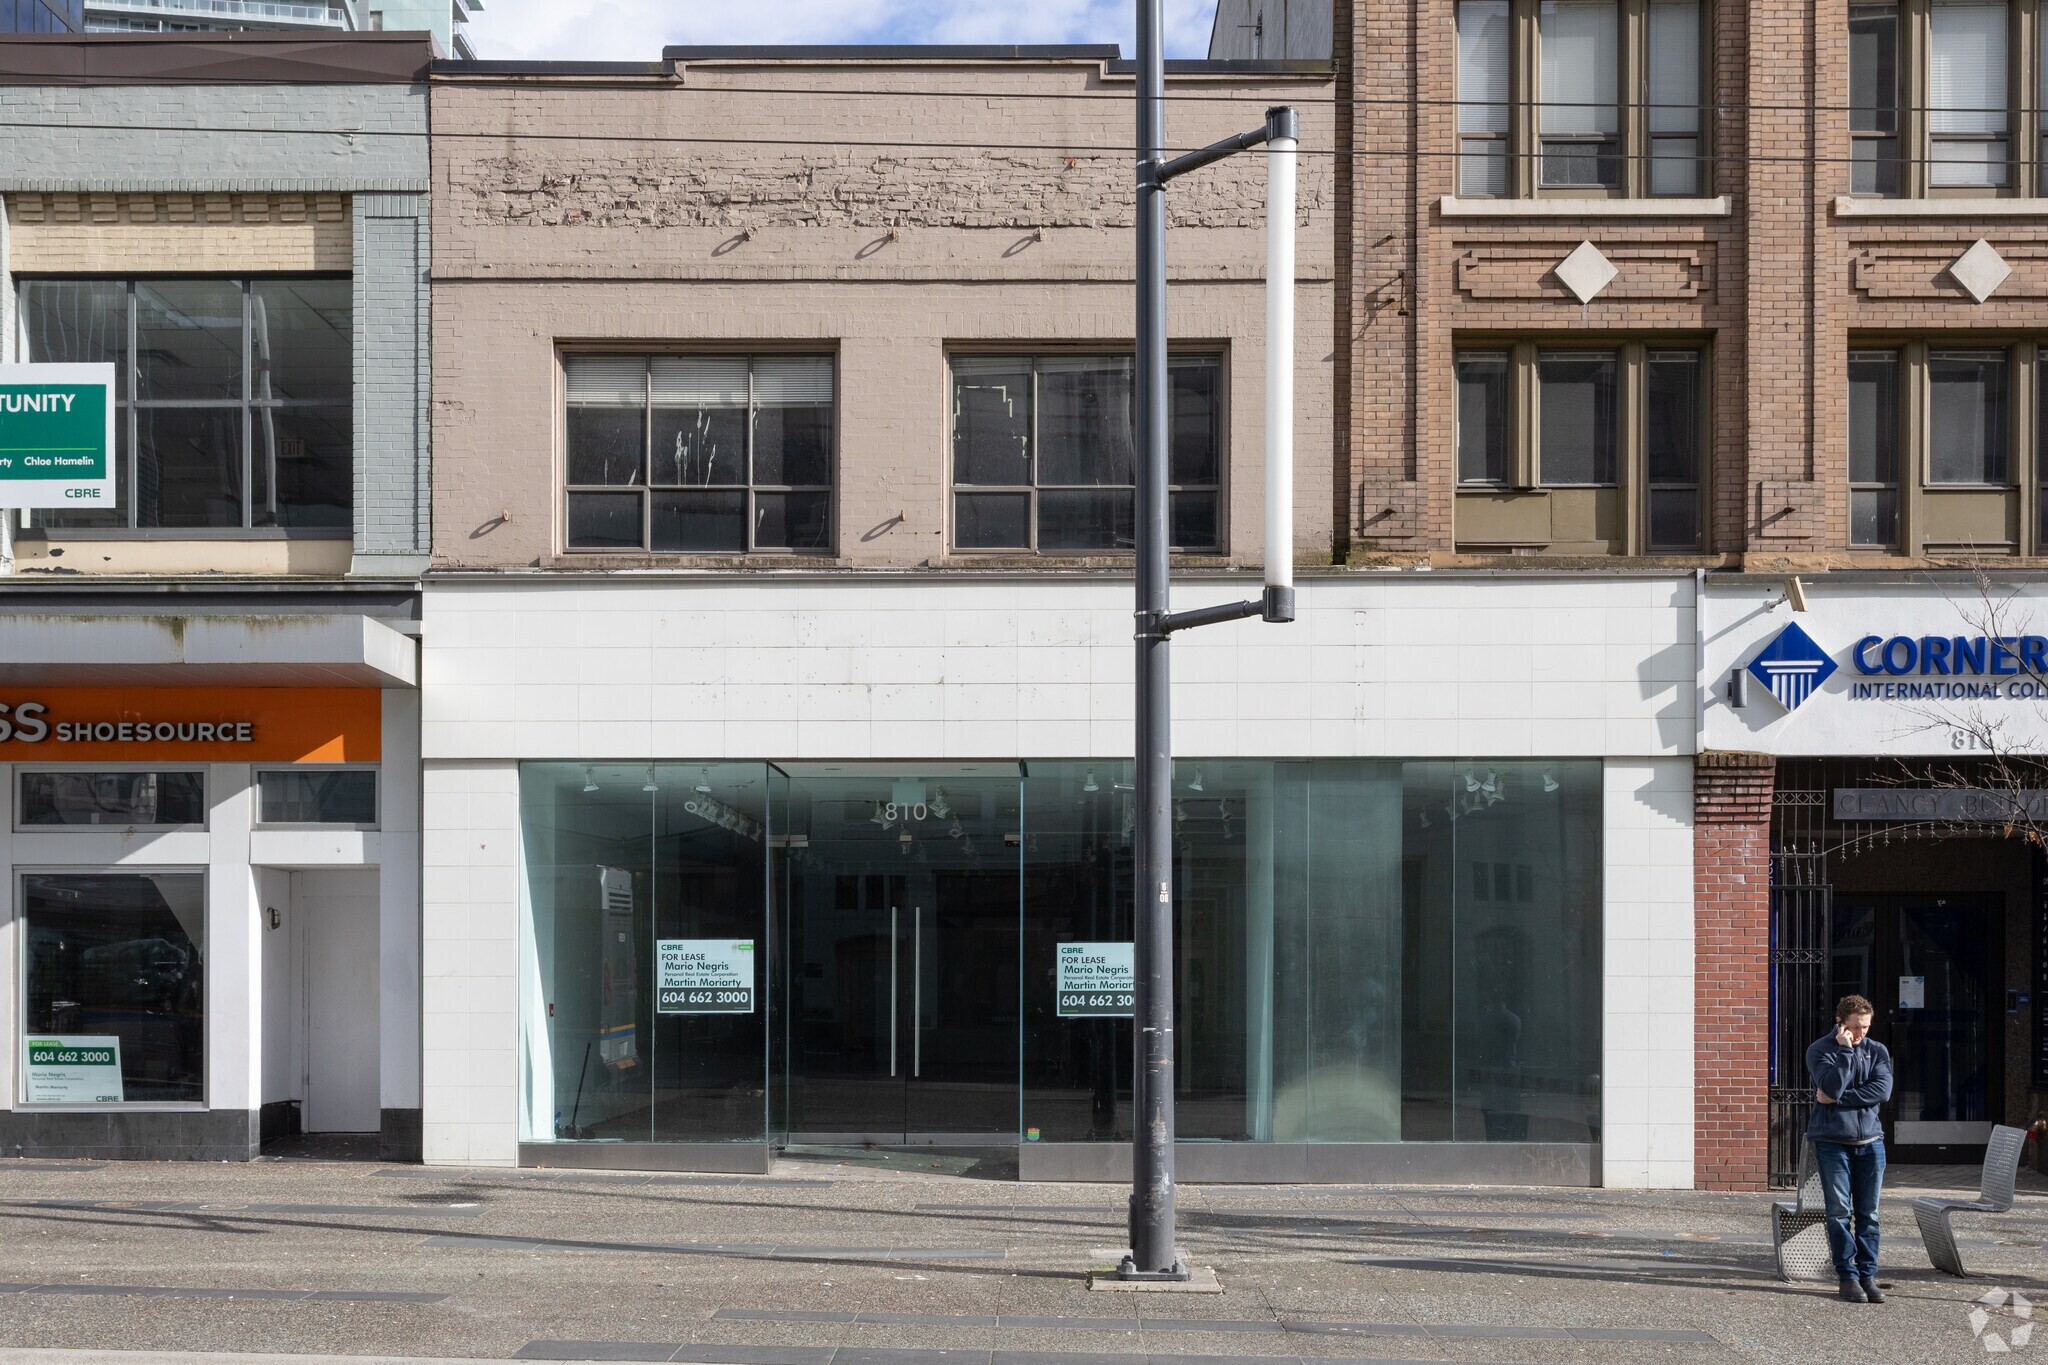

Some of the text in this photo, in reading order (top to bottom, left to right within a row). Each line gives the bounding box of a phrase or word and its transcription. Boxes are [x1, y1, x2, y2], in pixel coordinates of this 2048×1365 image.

[24, 456, 51, 466] Chloe
[54, 456, 94, 466] Hamelin
[65, 488, 101, 498] CBRE
[1853, 634, 2048, 676] CORNER
[1853, 682, 2048, 698] INTERNATIONAL COL
[56, 722, 252, 742] SHOESOURCE
[1840, 794, 1942, 814] CLANCY
[885, 802, 927, 821] 810
[1061, 956, 1106, 964] FOR LEASE
[665, 961, 729, 972] Mario Negris
[1064, 965, 1129, 975] Mario Negris
[664, 978, 741, 988] Martin Moriarty
[1064, 980, 1096, 989] Martin
[662, 991, 748, 1003] 604 662 3000
[1062, 994, 1134, 1006] 604 662 30
[33, 1051, 110, 1062] 604 662 3000
